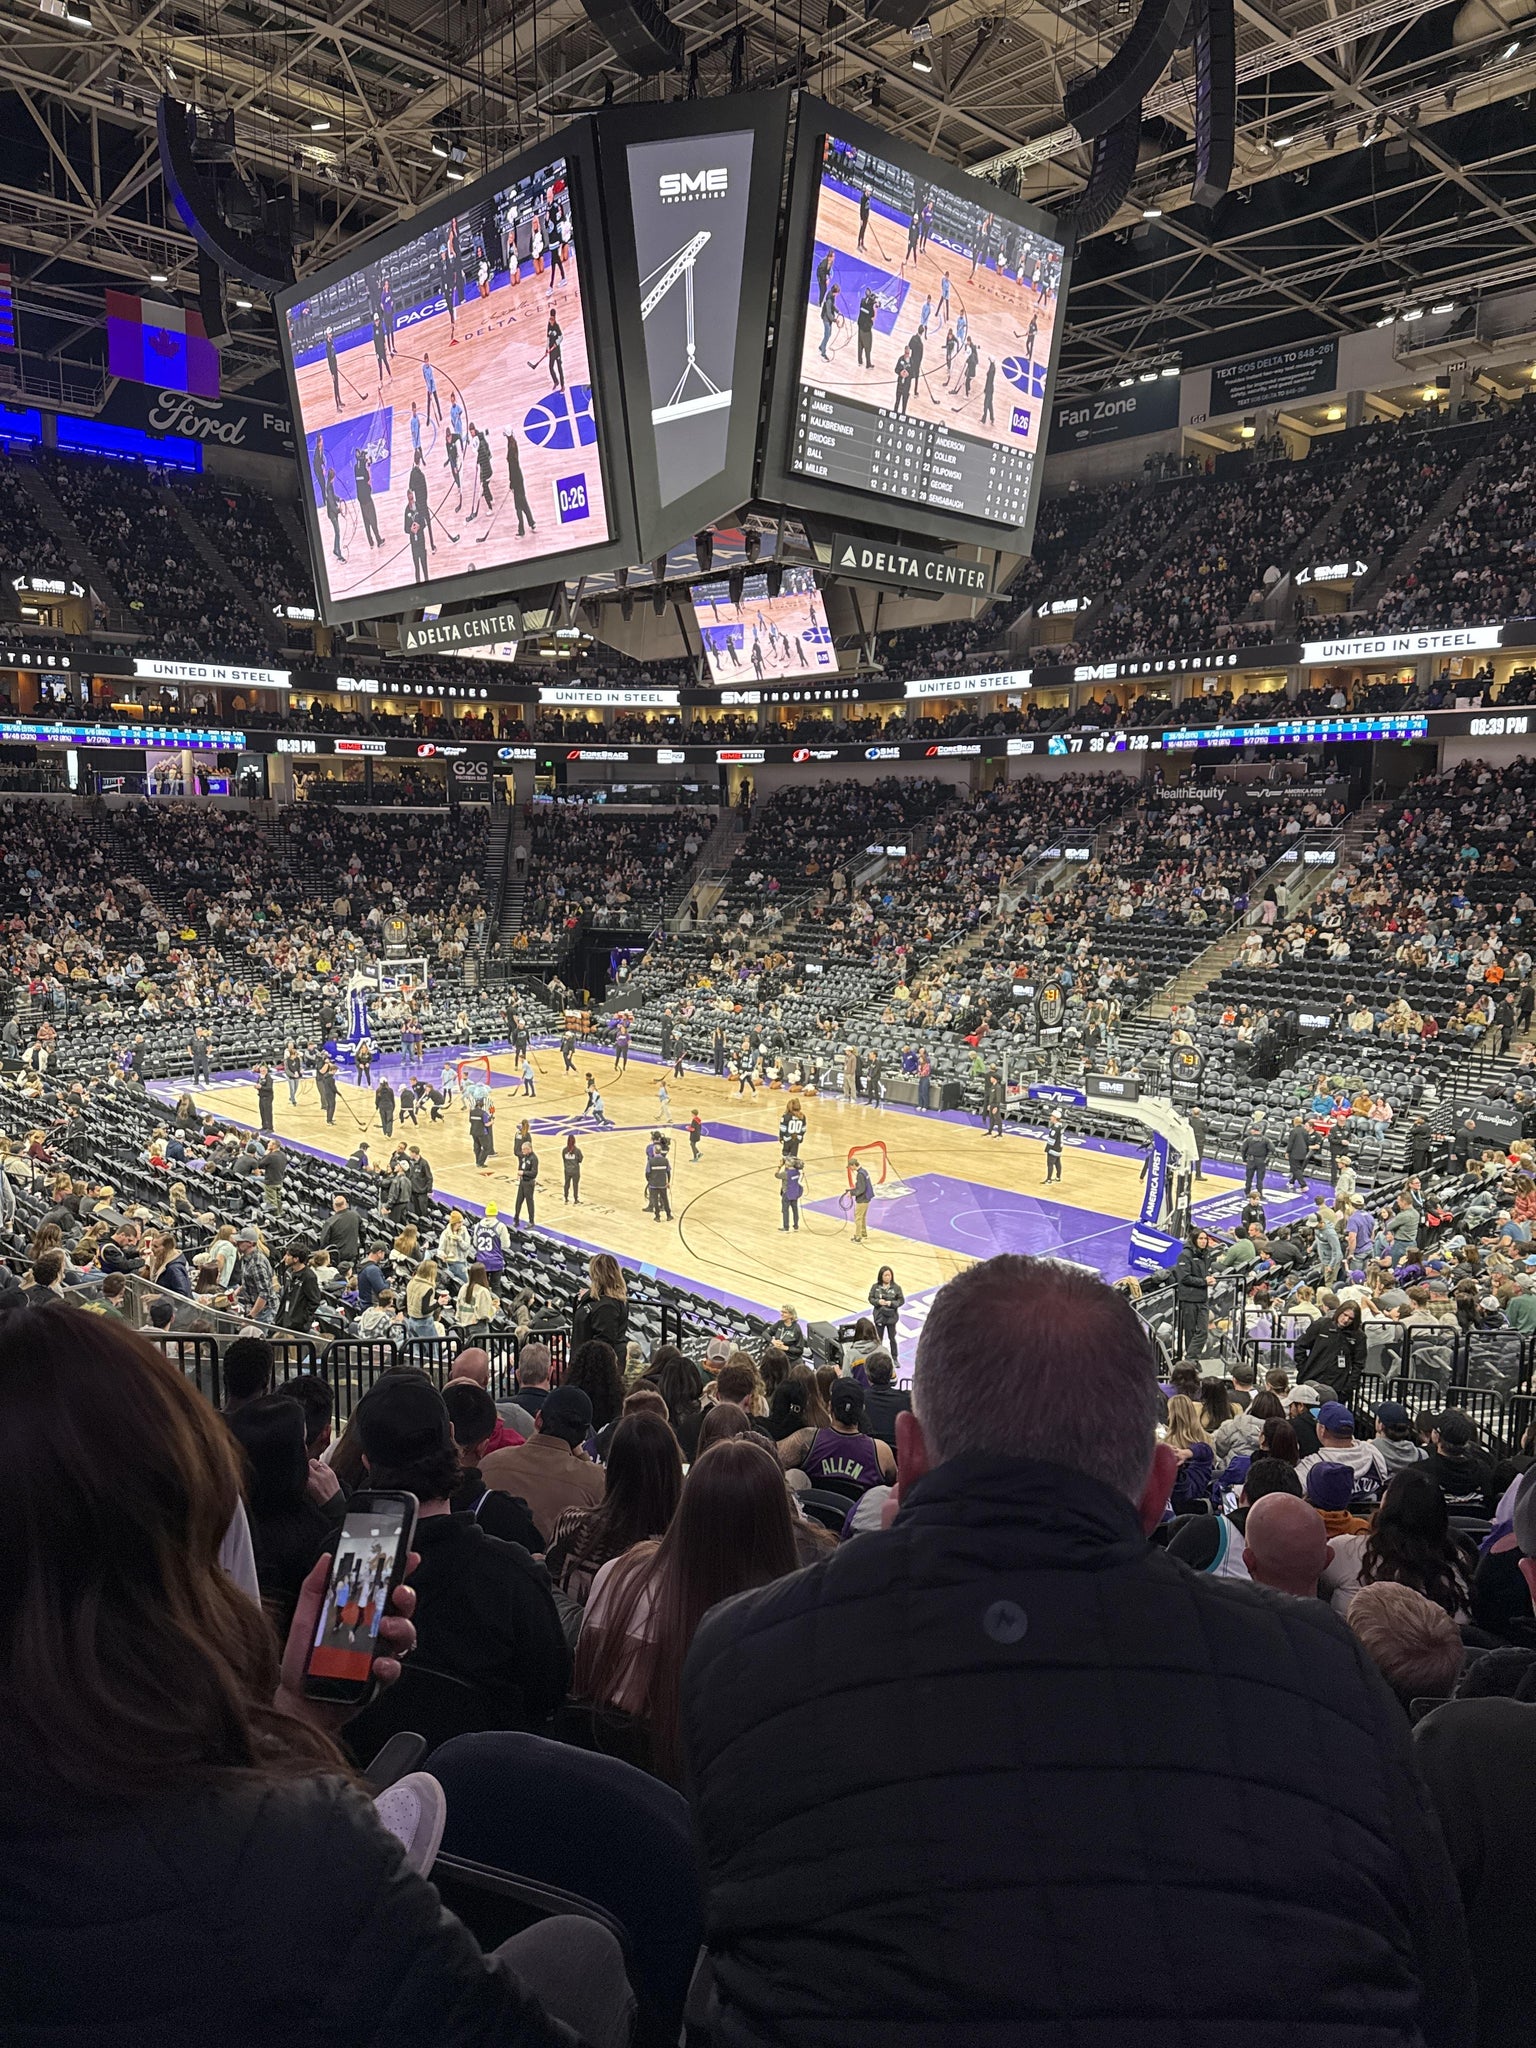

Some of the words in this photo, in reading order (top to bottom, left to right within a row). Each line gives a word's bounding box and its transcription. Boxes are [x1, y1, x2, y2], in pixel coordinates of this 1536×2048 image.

[659, 168, 728, 197] SME
[662, 190, 726, 204] INDUSTRIES
[930, 232, 974, 258] PACS
[396, 298, 448, 328] PACS
[464, 316, 518, 341] DELTA
[1215, 367, 1237, 379] TEXT
[1237, 362, 1256, 374] SOS
[1256, 355, 1284, 370] DELTA
[1283, 352, 1297, 363] TO
[1297, 343, 1335, 360] 848-261
[148, 390, 248, 445] Ford
[802, 398, 808, 407] 4
[811, 400, 834, 415] JAMES
[878, 420, 884, 429] 0
[898, 426, 904, 435] 2
[907, 428, 916, 438] 09
[1012, 413, 1029, 430] 0:26
[1058, 408, 1090, 428] Fan
[1093, 397, 1137, 420] Zone
[800, 413, 807, 422] 11
[810, 416, 854, 436] KALKBRENNER
[876, 435, 882, 444] 4
[887, 438, 893, 447] 4
[896, 440, 902, 450] 0
[905, 443, 914, 453] 09
[916, 446, 922, 455] 0
[935, 437, 966, 453] ANDERSON
[798, 429, 805, 438] 0
[808, 431, 836, 447] BRIDGES
[874, 450, 881, 459] 11
[885, 453, 891, 462] 4
[904, 458, 911, 467] 15
[807, 447, 823, 460] BALL
[872, 464, 879, 474] 14
[883, 467, 889, 476] 4
[902, 472, 909, 482] 15
[934, 451, 957, 465] COLLIER
[989, 467, 996, 476] 10
[1015, 474, 1022, 482] 14
[793, 459, 803, 470] 24
[805, 462, 828, 477] MILLER
[870, 479, 878, 488] 12
[881, 482, 887, 491] 3
[891, 484, 897, 493] 4
[901, 487, 908, 496] 15
[922, 463, 931, 472] 22
[932, 465, 962, 481] FILIPOWSKI
[1013, 487, 1020, 496] 12
[560, 485, 586, 512] 0:26
[930, 480, 953, 493] GEORGE
[995, 496, 1001, 505] 2
[928, 493, 964, 510] SENSABAUGH
[1009, 514, 1016, 522] 14
[861, 549, 919, 577] DELTA
[924, 562, 985, 589] CENTER
[418, 624, 462, 646] DELTA
[463, 614, 516, 638] CENTER
[1323, 641, 1386, 657] UNITED
[1393, 639, 1410, 650] IN
[1417, 633, 1477, 649] STEEL
[153, 664, 208, 678] UNITED
[212, 669, 226, 679] IN
[231, 671, 275, 683] STEEL
[1074, 663, 1117, 682] SME
[1120, 654, 1237, 676] INDUSTRIES
[336, 677, 379, 693] SME
[382, 682, 488, 698] INDUSTRIES
[919, 681, 961, 693] UNITED
[964, 679, 976, 689] IN
[980, 676, 1016, 687] STEEL
[555, 692, 602, 702] UNITED
[606, 692, 619, 702] IN
[624, 693, 664, 702] STEEL
[721, 691, 761, 705] SME
[764, 689, 859, 702] INDUSTRIES
[1396, 730, 1405, 738] 74
[1469, 717, 1504, 736] 08:39
[1505, 716, 1528, 734] PM
[302, 740, 316, 754] PM
[338, 743, 362, 751] SME
[720, 752, 742, 760] SME
[1070, 739, 1083, 753] 77
[452, 761, 488, 776] G2G
[1156, 787, 1225, 801] HealthEquity
[1304, 851, 1336, 861] SME
[1299, 1014, 1331, 1024] SME
[1180, 1053, 1198, 1065] 7:31
[149, 1077, 257, 1097] UTAH
[1098, 1081, 1124, 1091] SME
[788, 1120, 803, 1134] 00
[1151, 1149, 1162, 1176] FIRST
[1146, 1177, 1159, 1217] AMERICA
[477, 1236, 493, 1251] 23
[821, 1457, 864, 1480] ALLEN
